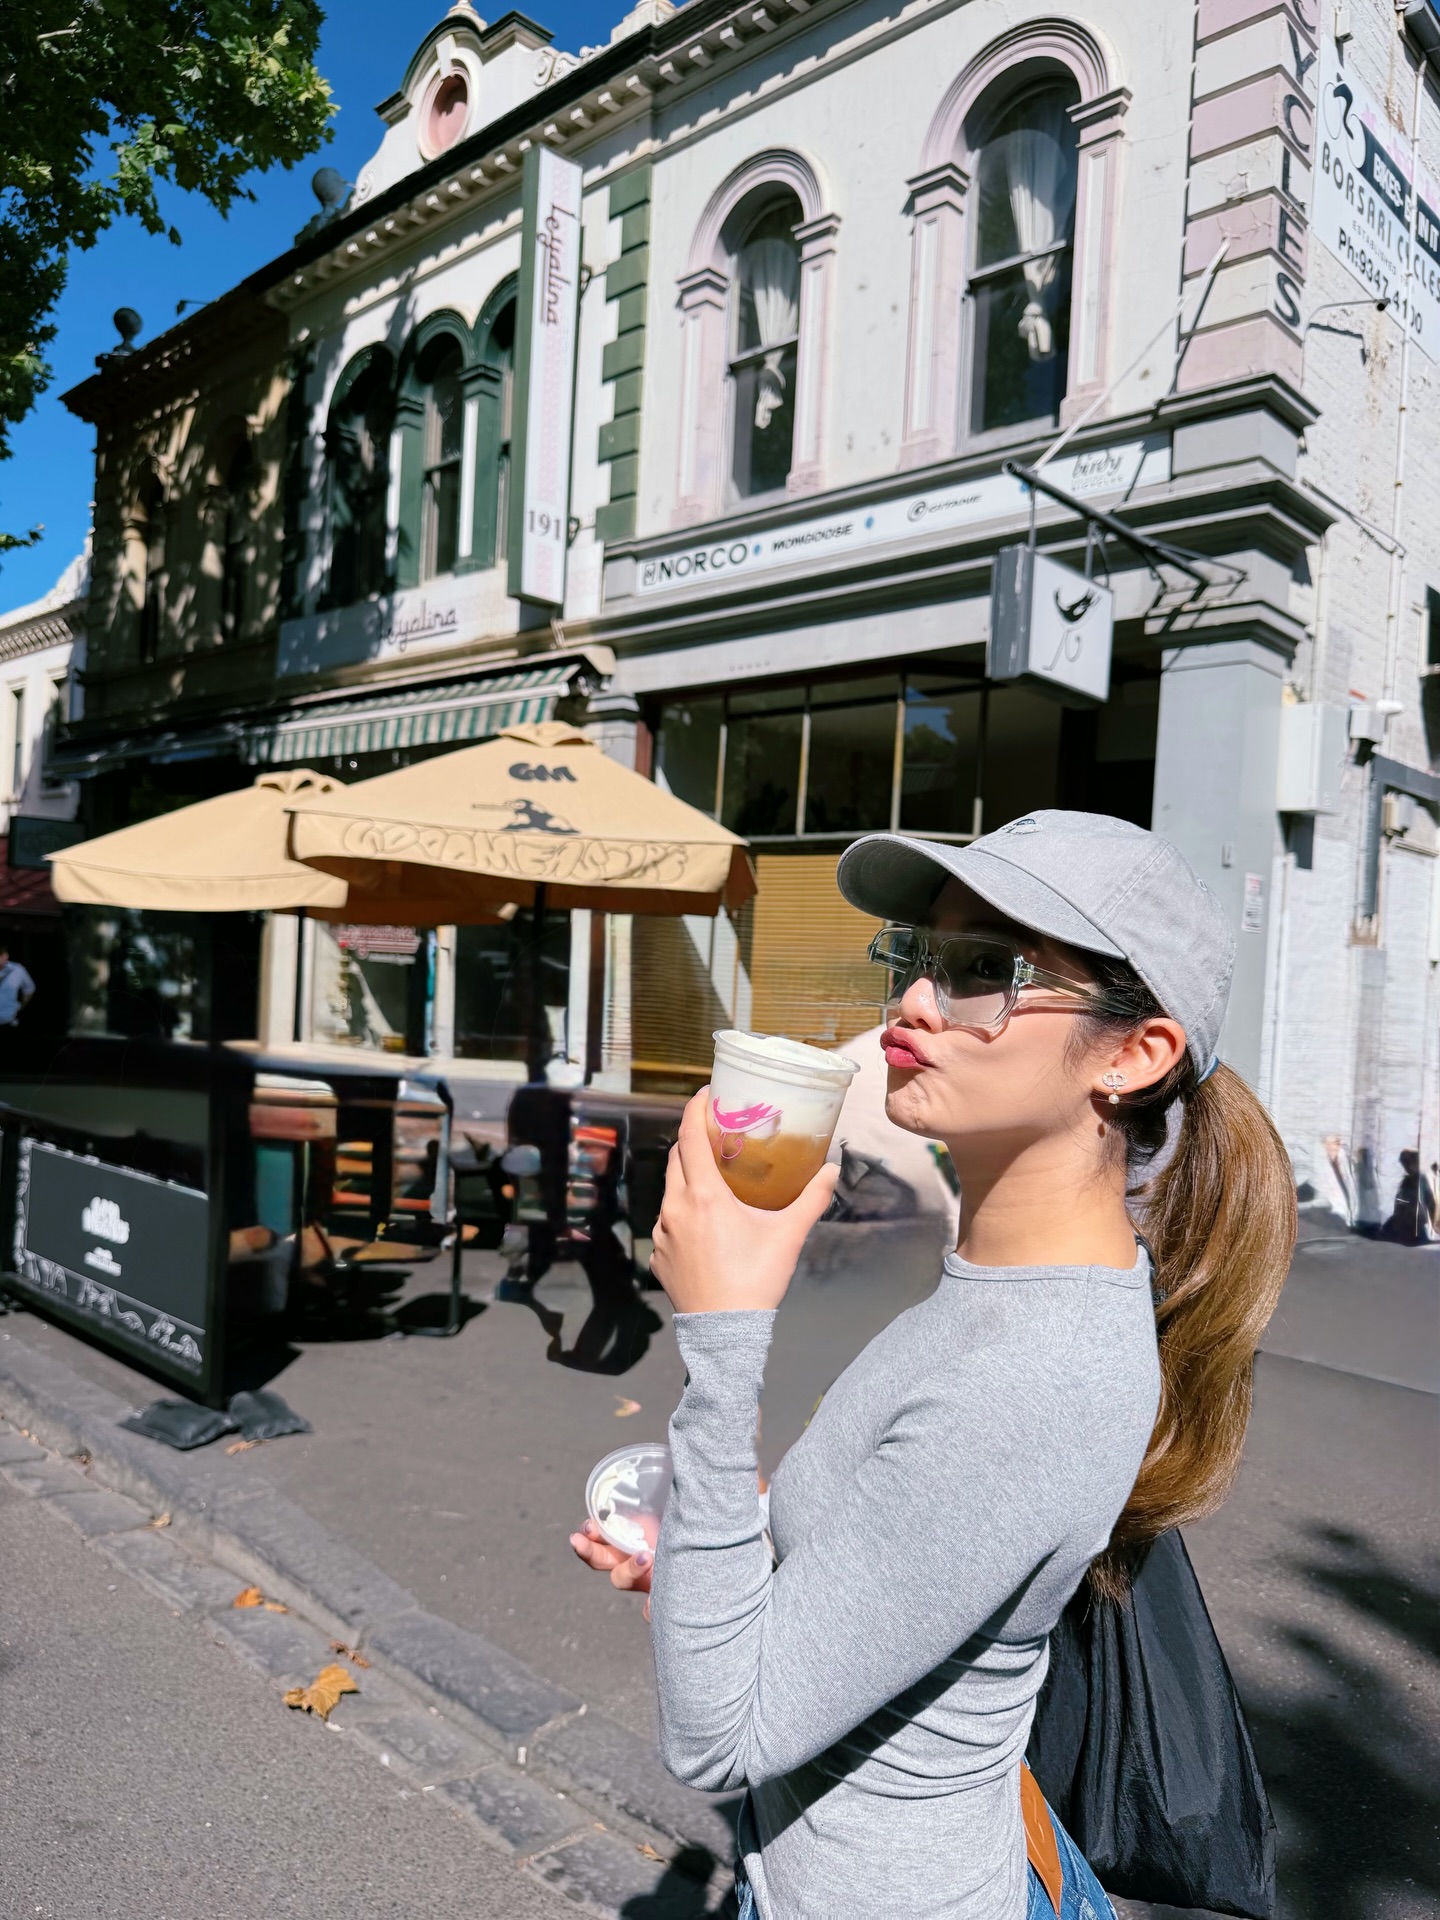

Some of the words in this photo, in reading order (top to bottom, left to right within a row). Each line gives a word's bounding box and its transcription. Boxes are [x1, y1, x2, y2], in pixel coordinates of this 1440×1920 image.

[1321, 141, 1392, 249] BORSARI
[529, 509, 562, 541] 191
[660, 542, 748, 582] NORCO
[772, 523, 854, 552] MONGOOSE
